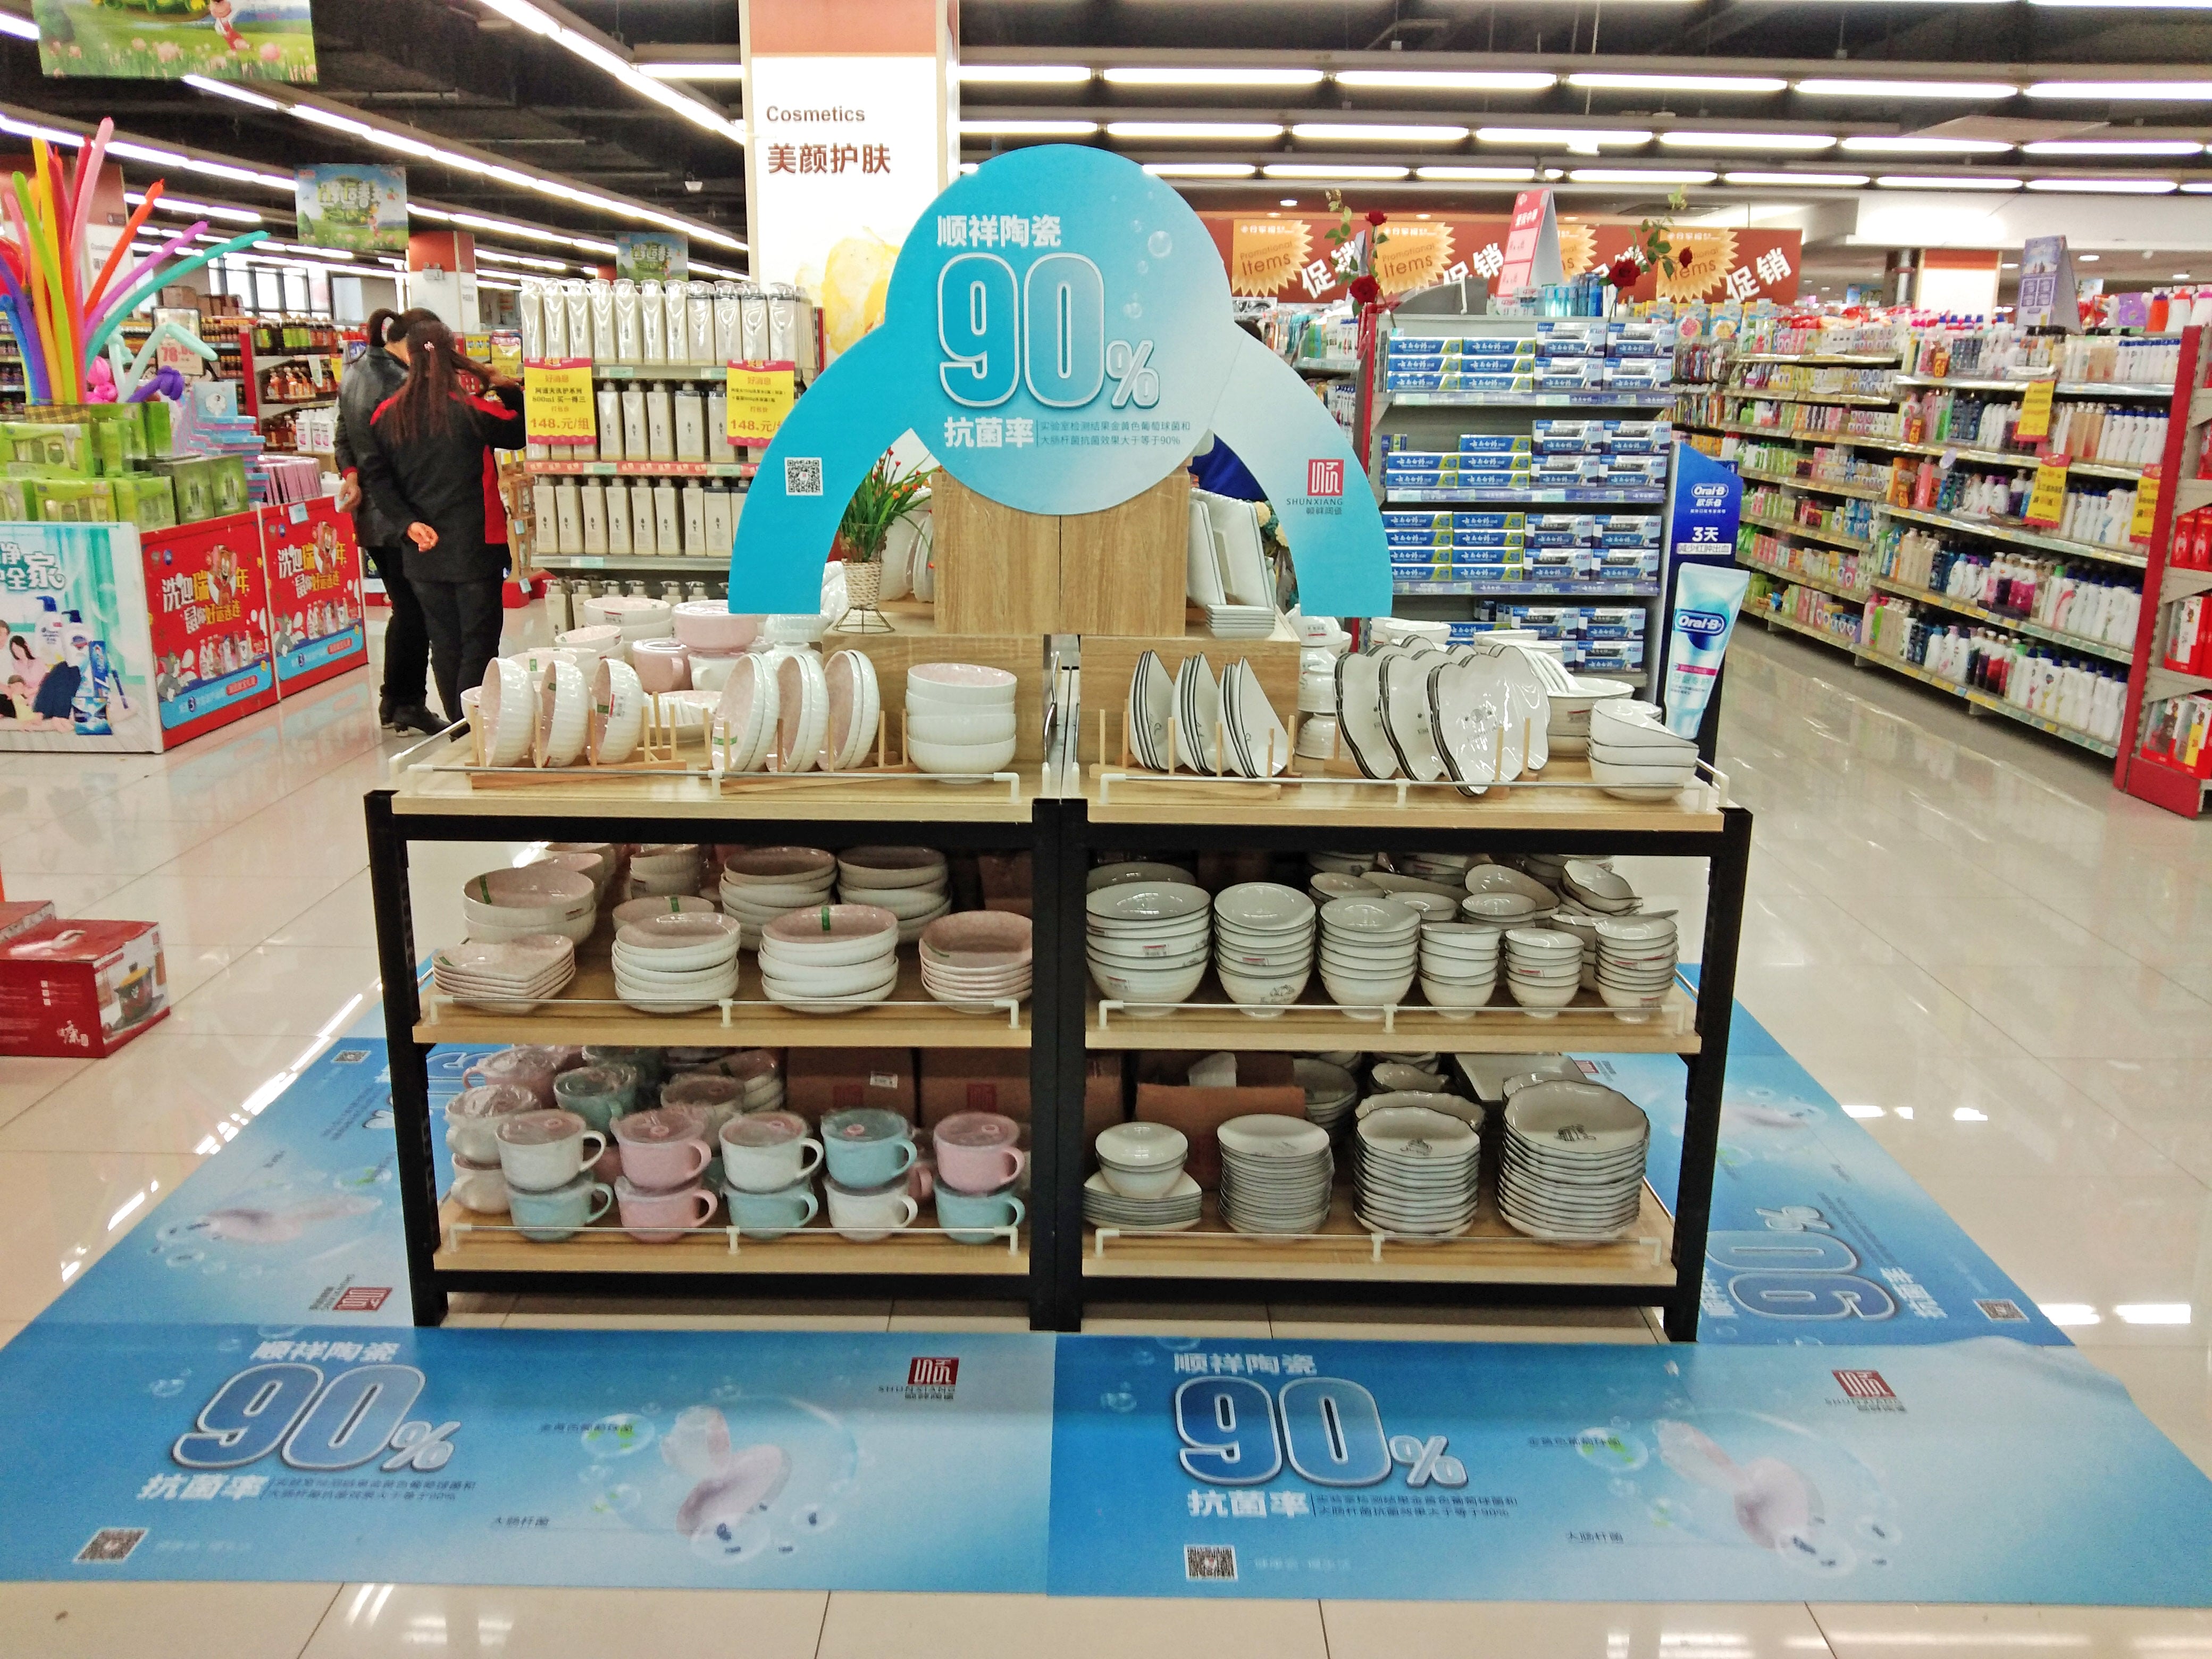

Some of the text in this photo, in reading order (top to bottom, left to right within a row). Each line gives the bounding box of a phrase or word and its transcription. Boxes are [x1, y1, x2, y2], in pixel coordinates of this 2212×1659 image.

[766, 105, 866, 123] Cosmetics
[768, 143, 892, 175] 美颜护肤
[937, 214, 1062, 248] 顺祥陶瓷
[1239, 241, 1293, 259] Promotional
[1381, 243, 1435, 262] Promotional
[1242, 254, 1291, 276] Items
[1384, 255, 1434, 278] Items
[1725, 247, 1791, 301] 促销
[937, 252, 1161, 409] 90%
[731, 419, 781, 432] 148.元/
[943, 417, 1035, 449] 抗菌率
[1040, 421, 1191, 432] 实验室检测结果金黄色葡萄球菌和
[1041, 435, 1181, 446] 大肠杆菌抗菌效果大于等于90%
[1694, 486, 1725, 496] Oral-B
[1692, 526, 1719, 542] 3天
[1679, 544, 1729, 554] 减少红肿出血
[1679, 617, 1719, 630] Oral-B
[249, 1340, 401, 1362] 顺祥陶瓷
[1174, 1353, 1317, 1376] 顺祥陶瓷
[171, 1363, 462, 1472] 90%
[1174, 1376, 1470, 1488] 90%
[136, 1473, 272, 1502] 抗菌率
[1187, 1489, 1310, 1518] 抗菌率
